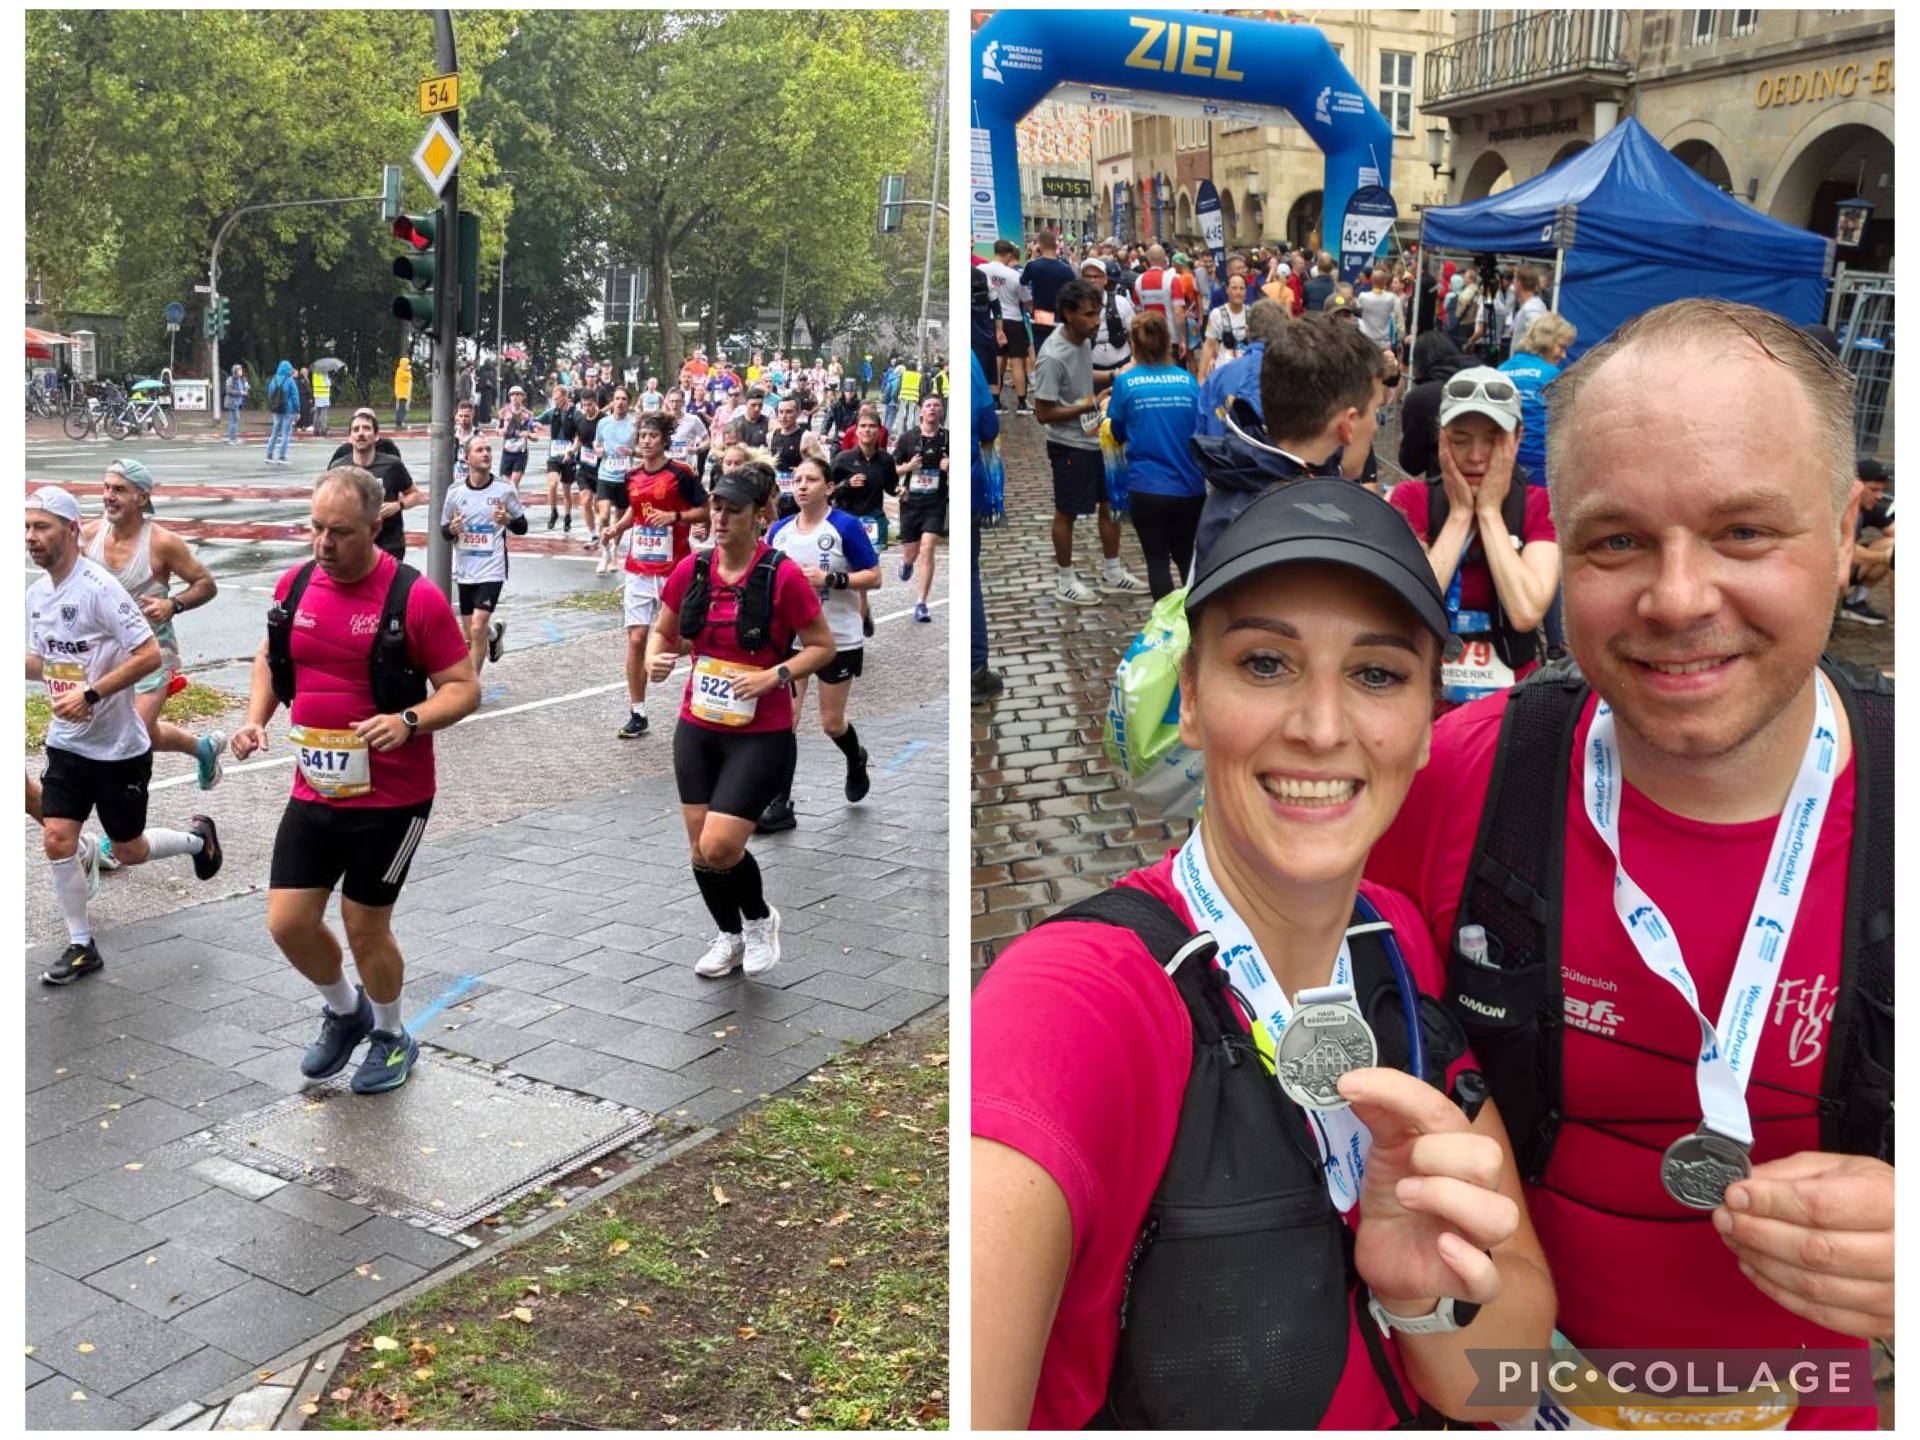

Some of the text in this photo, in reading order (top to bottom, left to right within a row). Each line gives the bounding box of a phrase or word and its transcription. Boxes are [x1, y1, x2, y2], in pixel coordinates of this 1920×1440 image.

[1001, 44, 1043, 55] VOLKSBANK
[1008, 52, 1043, 63] MÜNSTER
[1124, 16, 1244, 81] ZIEL
[1001, 60, 1043, 70] MARATHON
[429, 82, 448, 106] 54
[1756, 58, 1895, 109] OEDING-E
[1046, 181, 1089, 194] 4:47:57
[1344, 229, 1377, 246] 4:45
[1127, 374, 1190, 387] DERMASENCE
[1441, 641, 1490, 666] 79
[700, 675, 738, 701] 522
[301, 747, 350, 771] 5417
[1777, 797, 1818, 897] WeckerDruckluft
[1561, 966, 1617, 993] Gütersloh
[1307, 1016, 1346, 1024] RÜSCHHAUS
